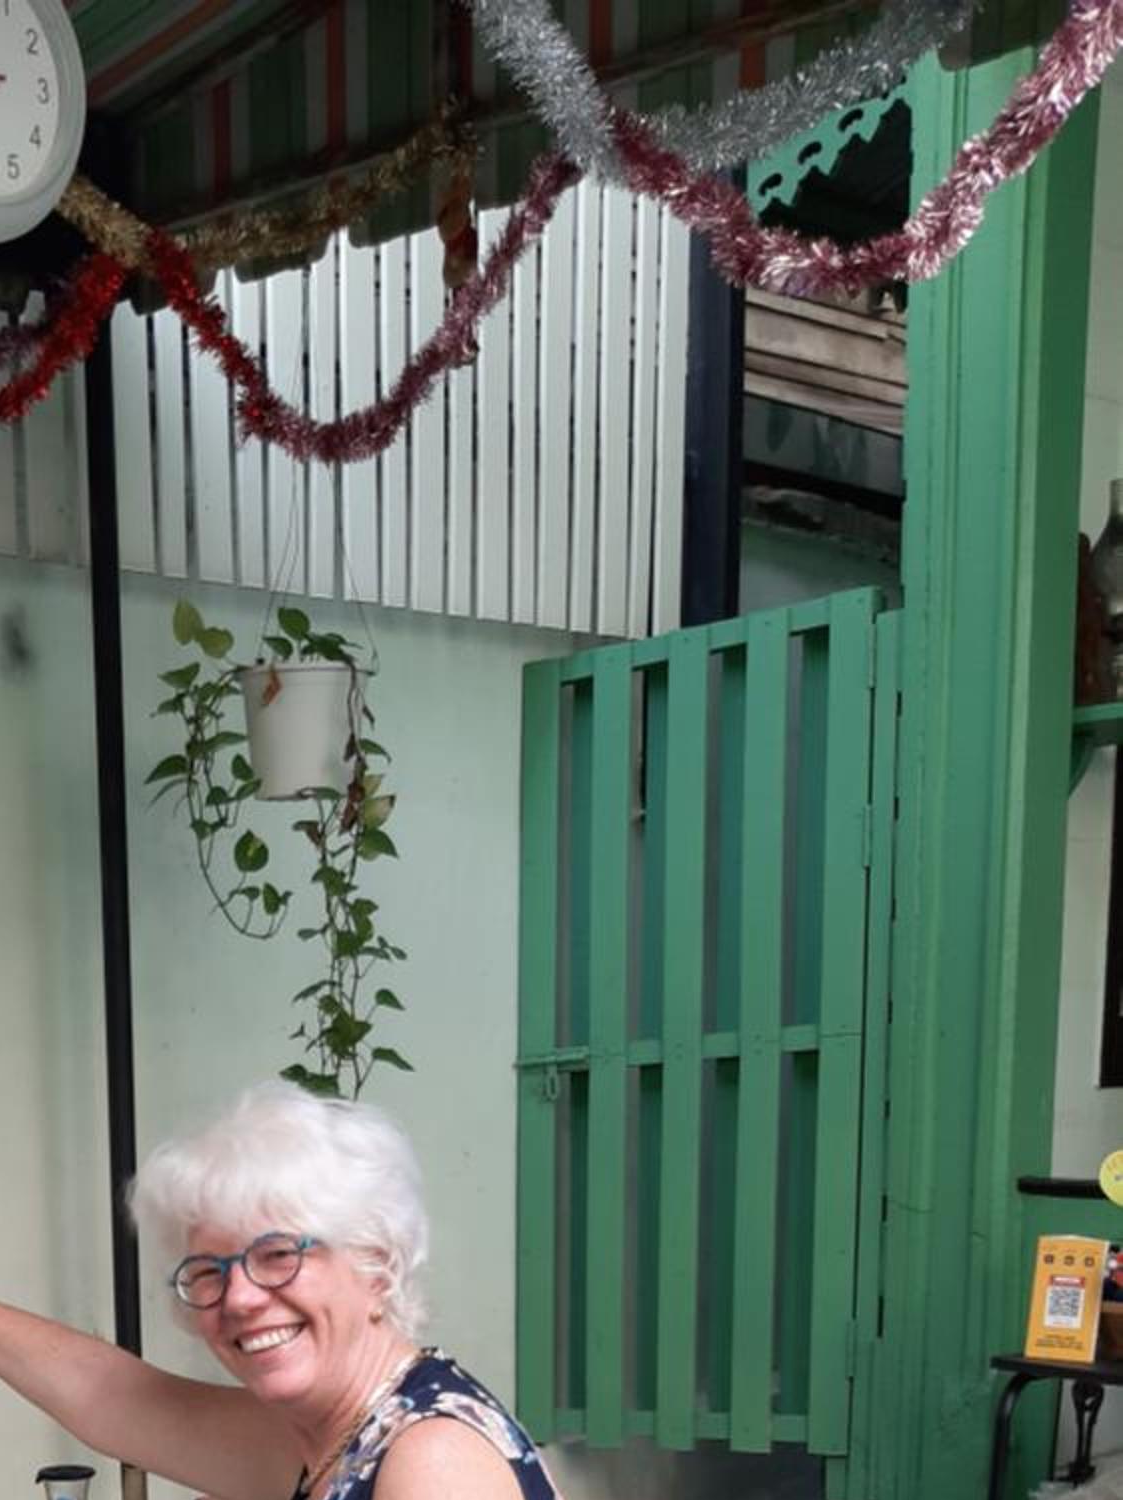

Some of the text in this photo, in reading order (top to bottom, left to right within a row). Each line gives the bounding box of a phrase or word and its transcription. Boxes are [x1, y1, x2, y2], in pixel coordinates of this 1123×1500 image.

[26, 28, 38, 55] 2
[37, 78, 51, 105] 3
[29, 125, 42, 149] 4
[8, 154, 21, 180] 5
